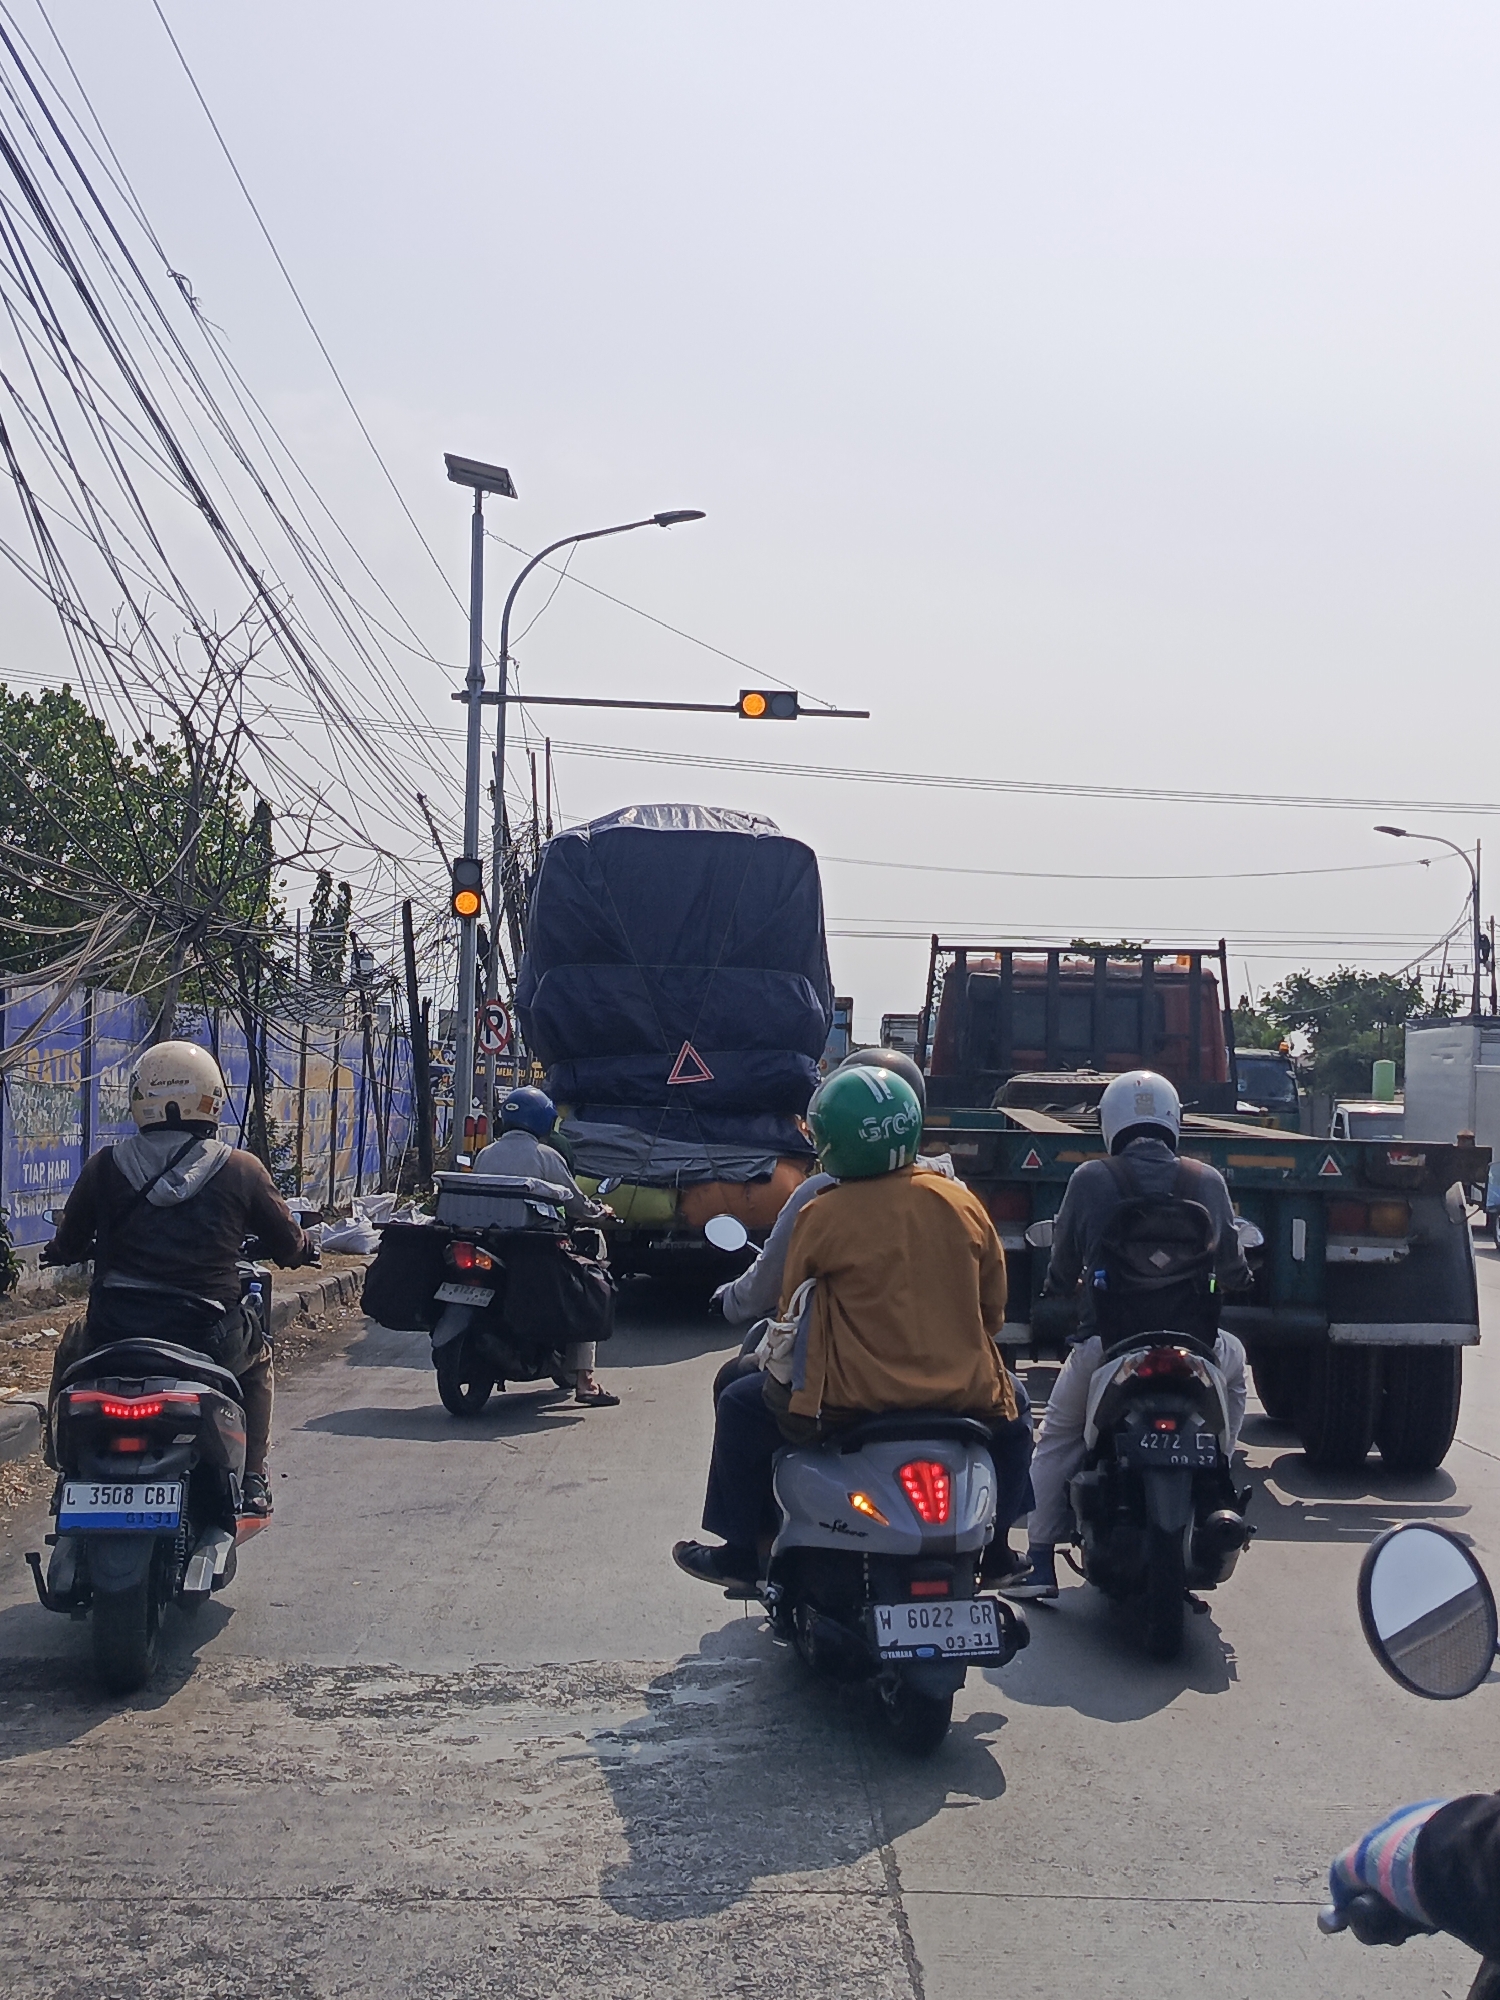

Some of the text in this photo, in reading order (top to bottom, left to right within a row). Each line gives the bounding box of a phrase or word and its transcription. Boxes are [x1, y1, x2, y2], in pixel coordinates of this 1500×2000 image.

[858, 1101, 919, 1142] Grab
[23, 1160, 70, 1184] TIAP HARI
[1140, 1433, 1181, 1449] 4272
[66, 1487, 177, 1506] L 3508 CBI
[879, 1605, 993, 1630] W 6022 GR
[887, 1650, 913, 1659] YAMAHA
